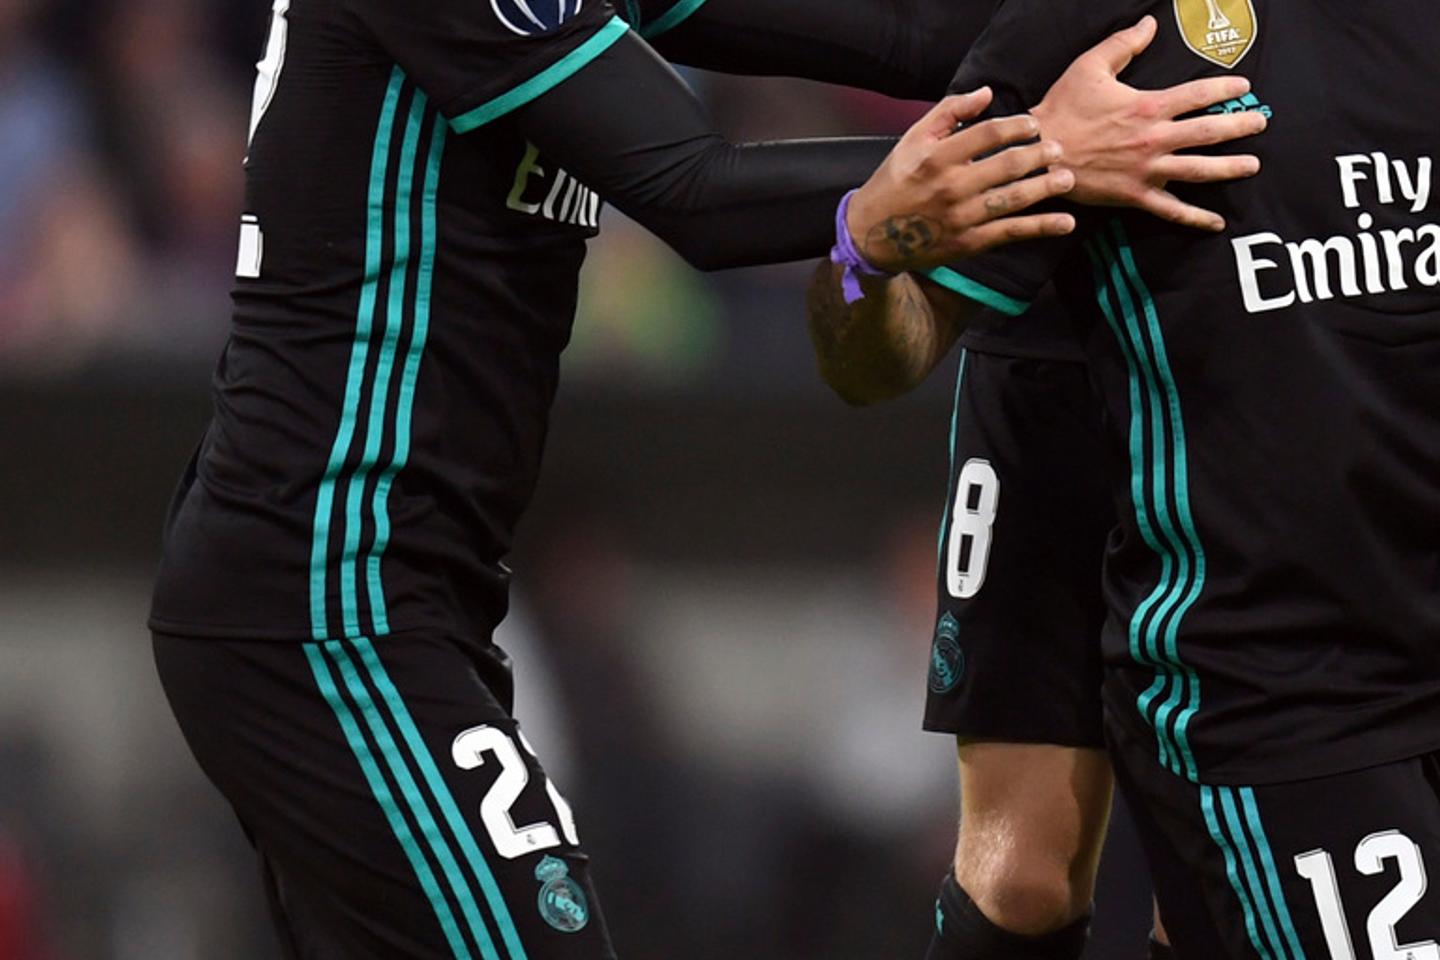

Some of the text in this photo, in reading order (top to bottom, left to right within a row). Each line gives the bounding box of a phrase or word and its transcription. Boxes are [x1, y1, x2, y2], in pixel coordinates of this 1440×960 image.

[1206, 29, 1240, 44] FIFA
[1336, 151, 1431, 212] Fly
[947, 458, 1000, 598] 8
